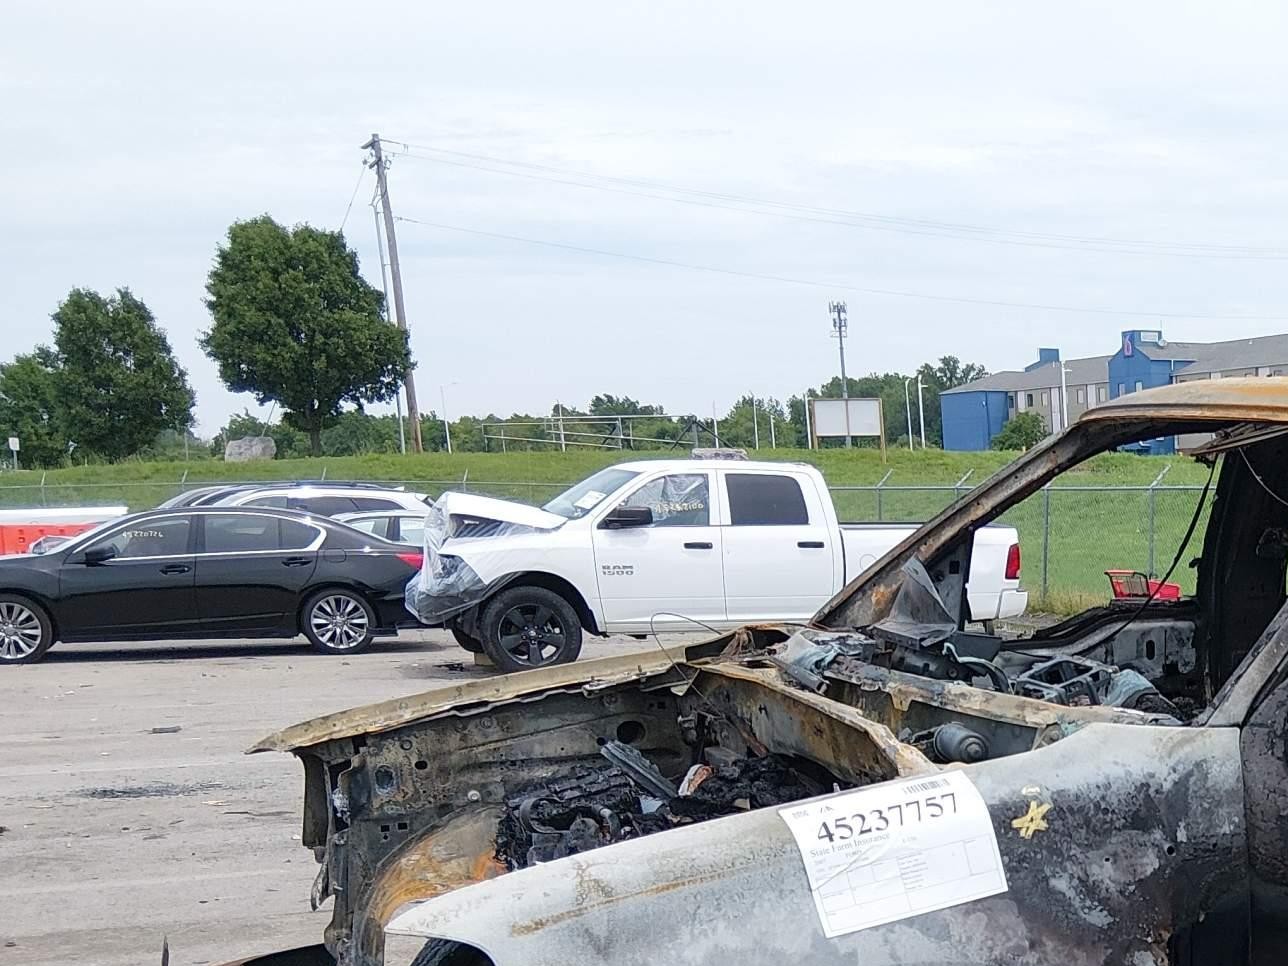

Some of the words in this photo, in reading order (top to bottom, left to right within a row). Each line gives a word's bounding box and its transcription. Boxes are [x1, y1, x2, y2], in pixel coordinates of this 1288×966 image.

[817, 792, 957, 842] 45237757
[810, 847, 831, 858] State
[831, 842, 854, 854] Farm
[854, 833, 890, 847] Insurance
